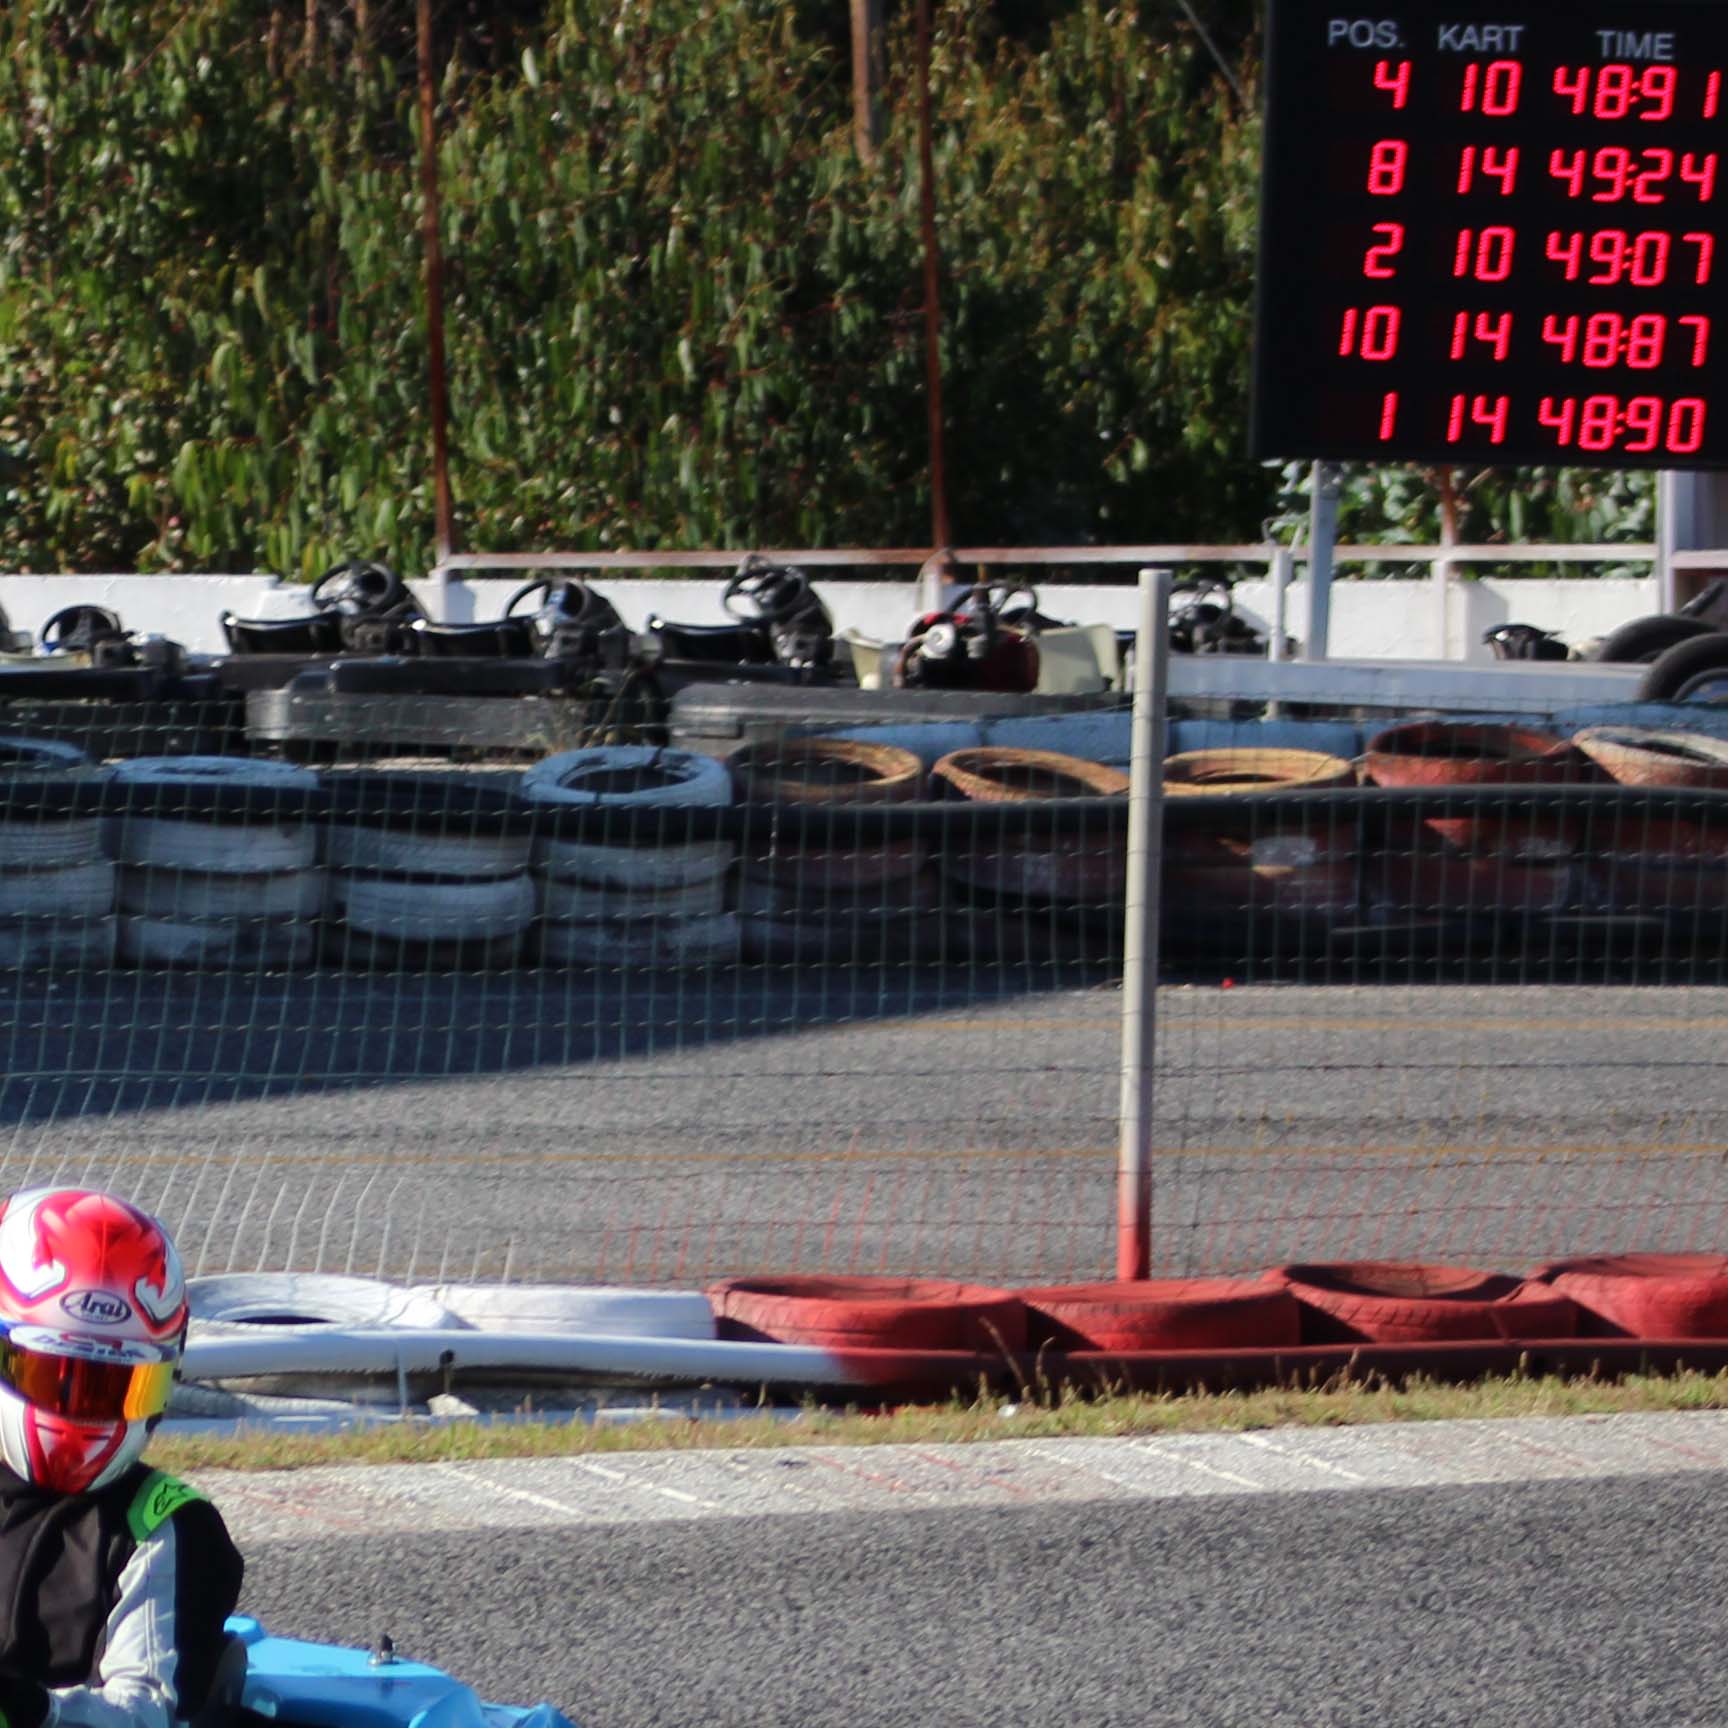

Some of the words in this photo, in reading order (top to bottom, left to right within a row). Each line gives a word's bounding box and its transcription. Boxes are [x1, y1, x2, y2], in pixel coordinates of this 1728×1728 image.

[1327, 19, 1406, 48] POS.
[1438, 24, 1524, 52] KART
[1596, 30, 1675, 60] TIME
[1373, 60, 1411, 109] 4
[1460, 60, 1522, 116] 10
[1553, 64, 1721, 120] 48:91
[1367, 140, 1408, 195] 8
[1457, 146, 1519, 195] 14
[1549, 147, 1718, 203] 49:24
[1363, 222, 1405, 278] 2
[1453, 226, 1516, 281] 10
[1546, 229, 1715, 287] 49:07
[1339, 305, 1401, 361] 10
[1450, 311, 1512, 361] 14
[1542, 313, 1711, 369] 48:87
[1379, 391, 1398, 441] 1
[1447, 394, 1509, 444] 14
[1538, 394, 1706, 453] 48:90
[67, 1291, 124, 1318] Arai
